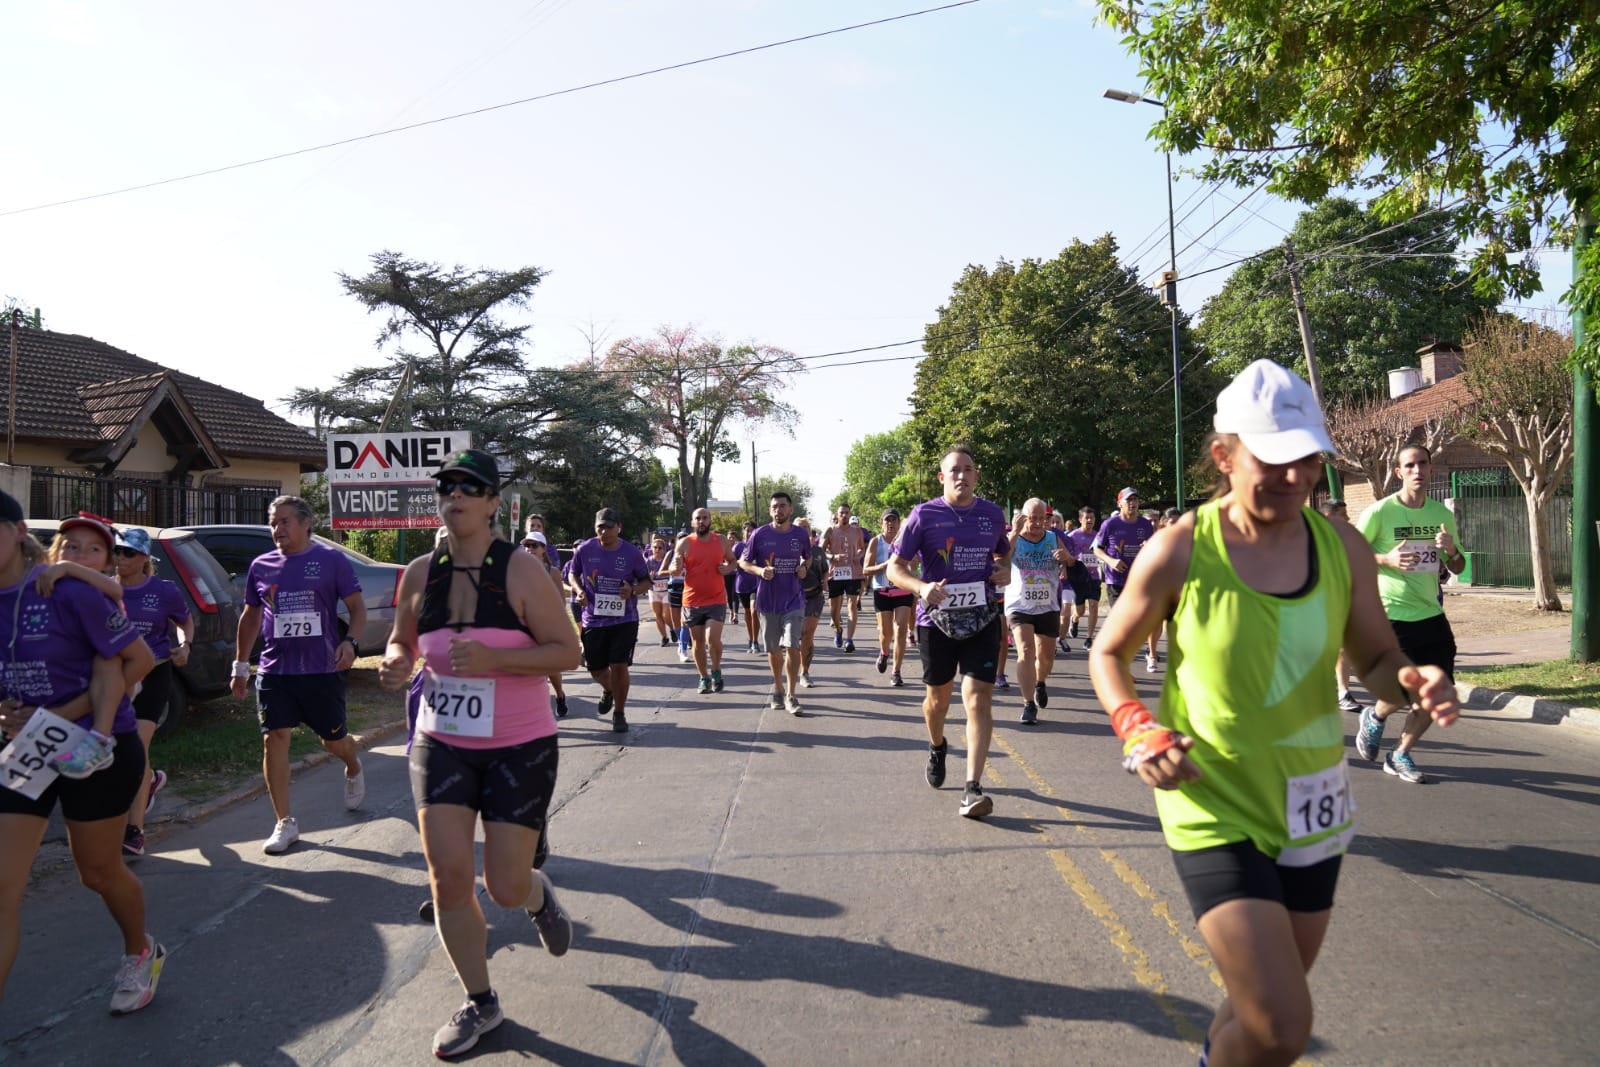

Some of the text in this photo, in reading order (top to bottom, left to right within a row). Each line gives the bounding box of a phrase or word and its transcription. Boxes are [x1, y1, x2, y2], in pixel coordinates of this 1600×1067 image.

[338, 490, 399, 513] VENDE
[949, 592, 977, 607] 272
[1025, 590, 1050, 600] 3829
[597, 600, 622, 610] 2769
[283, 622, 312, 636] 279
[427, 690, 482, 719] 4270
[8, 726, 69, 780] 1540
